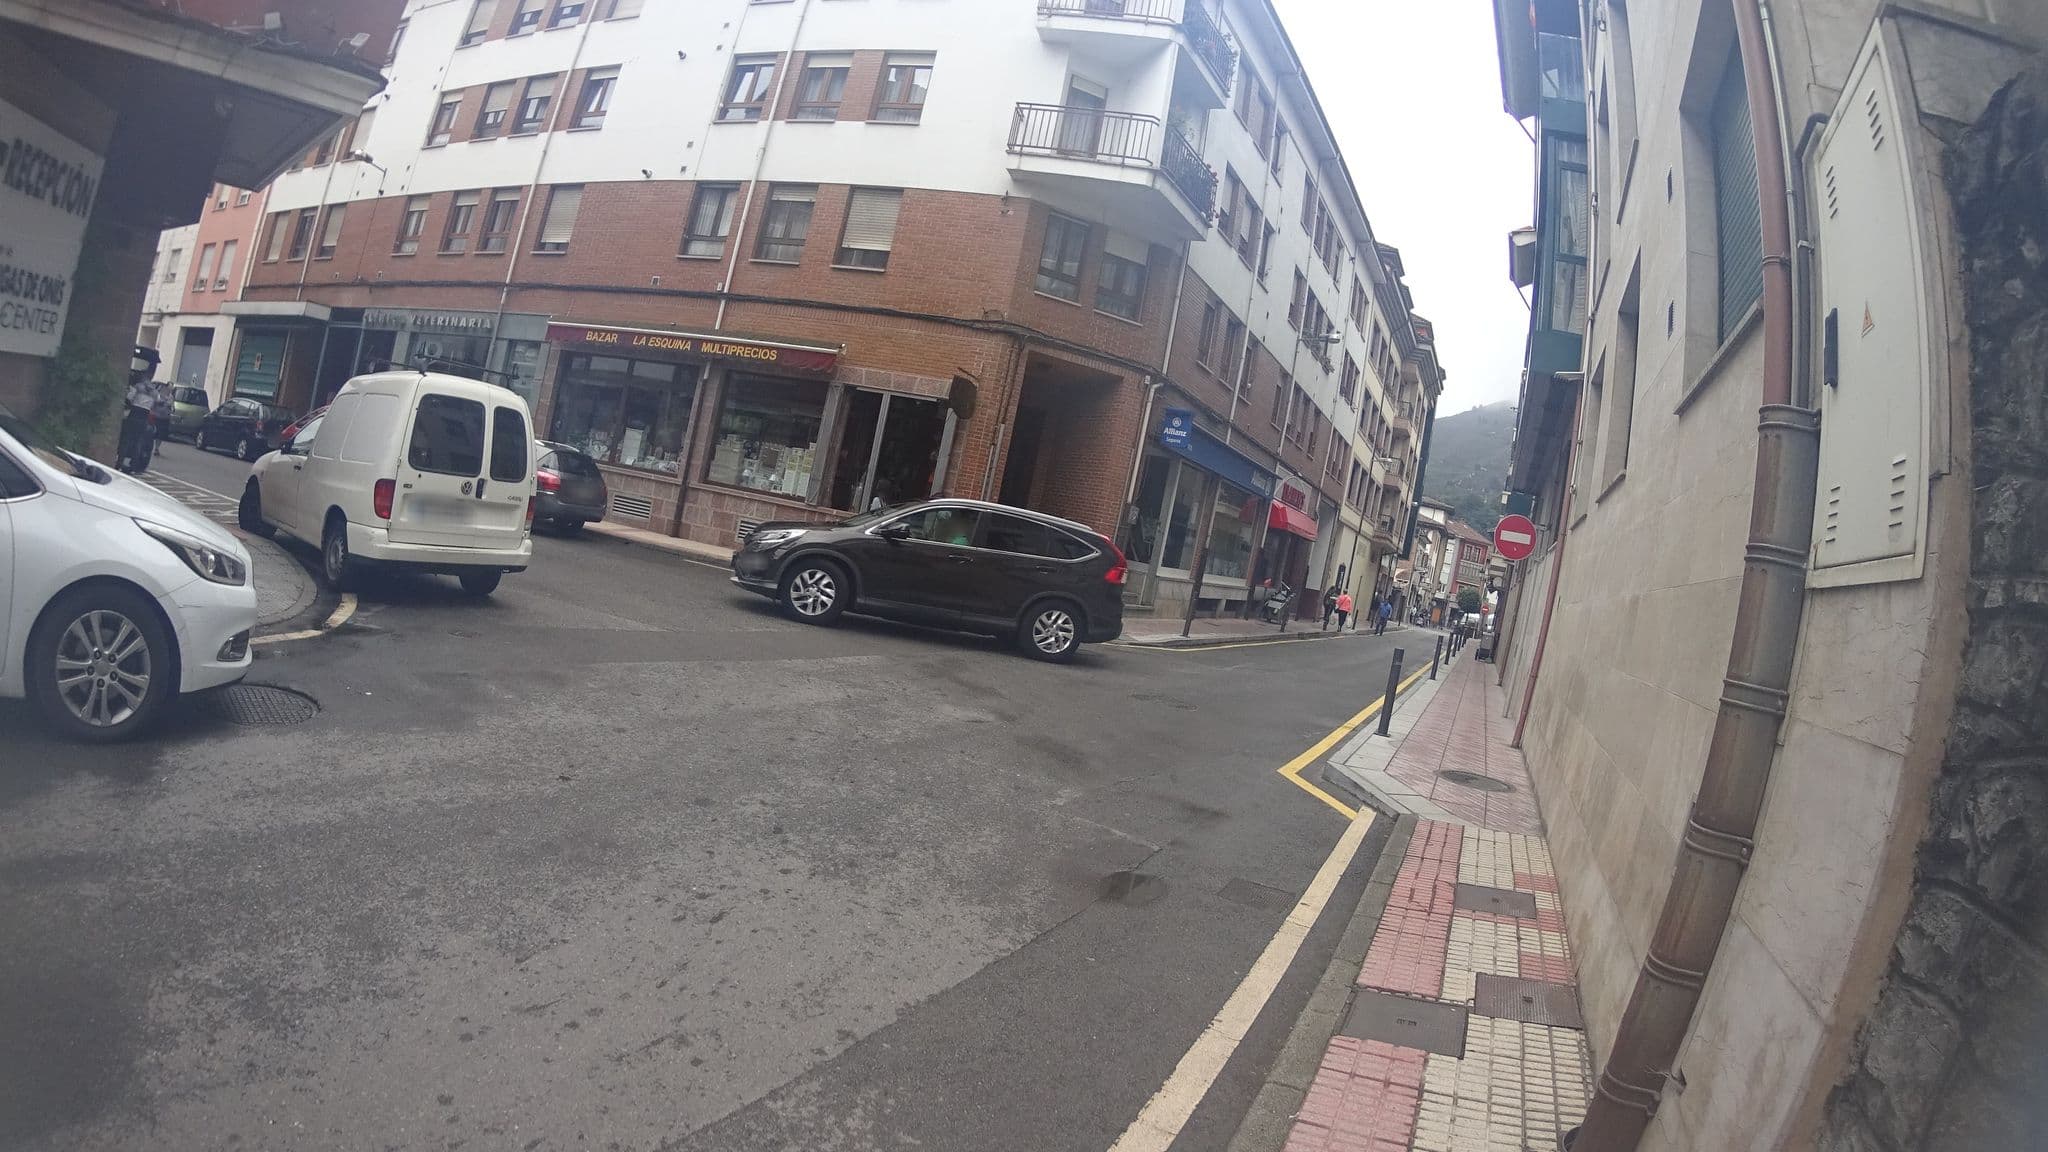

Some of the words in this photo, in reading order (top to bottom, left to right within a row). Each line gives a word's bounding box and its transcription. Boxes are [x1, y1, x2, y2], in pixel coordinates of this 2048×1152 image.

[585, 330, 618, 344] BAZAR
[632, 335, 646, 346] LA
[648, 337, 692, 351] ESQUINA
[701, 342, 778, 361] MULTIPRECIOS
[1163, 427, 1188, 437] Allianz
